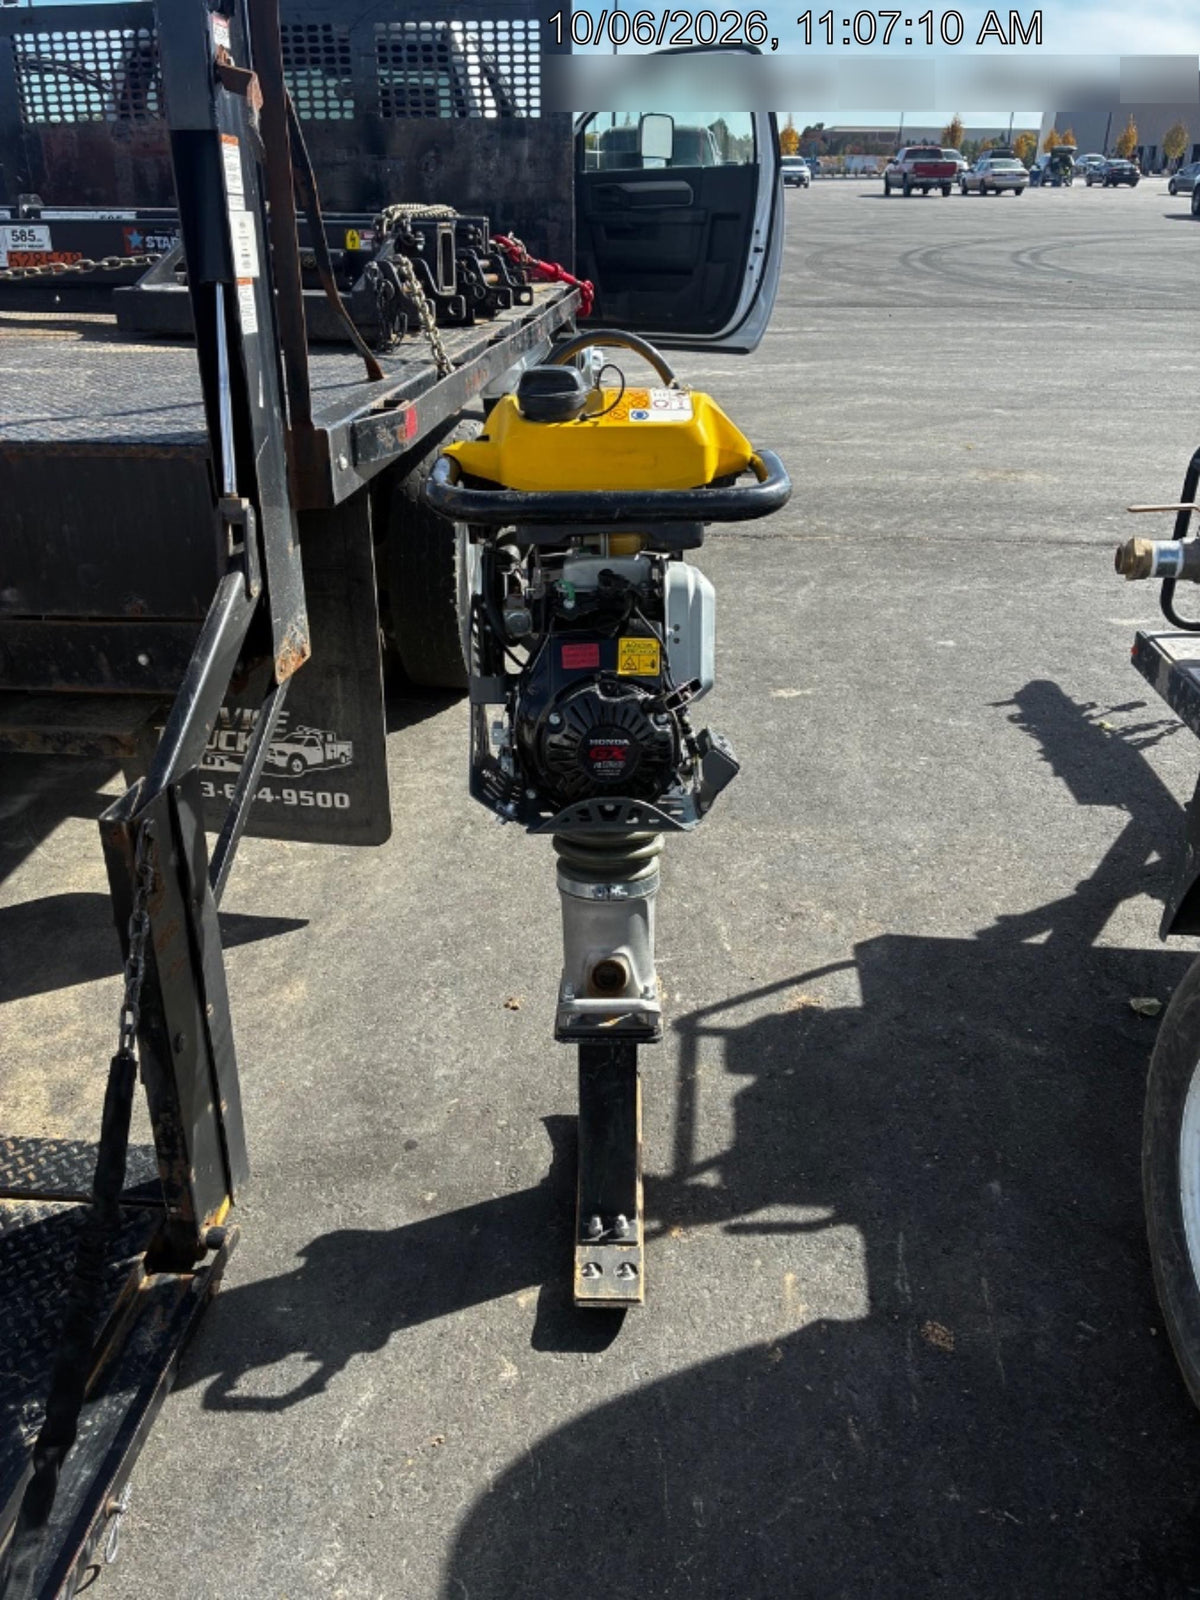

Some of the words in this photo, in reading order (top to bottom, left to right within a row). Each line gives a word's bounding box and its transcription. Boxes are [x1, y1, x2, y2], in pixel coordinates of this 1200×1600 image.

[11, 229, 37, 243] 585
[589, 738, 631, 746] HONDA
[200, 781, 351, 809] 3-64-9500
